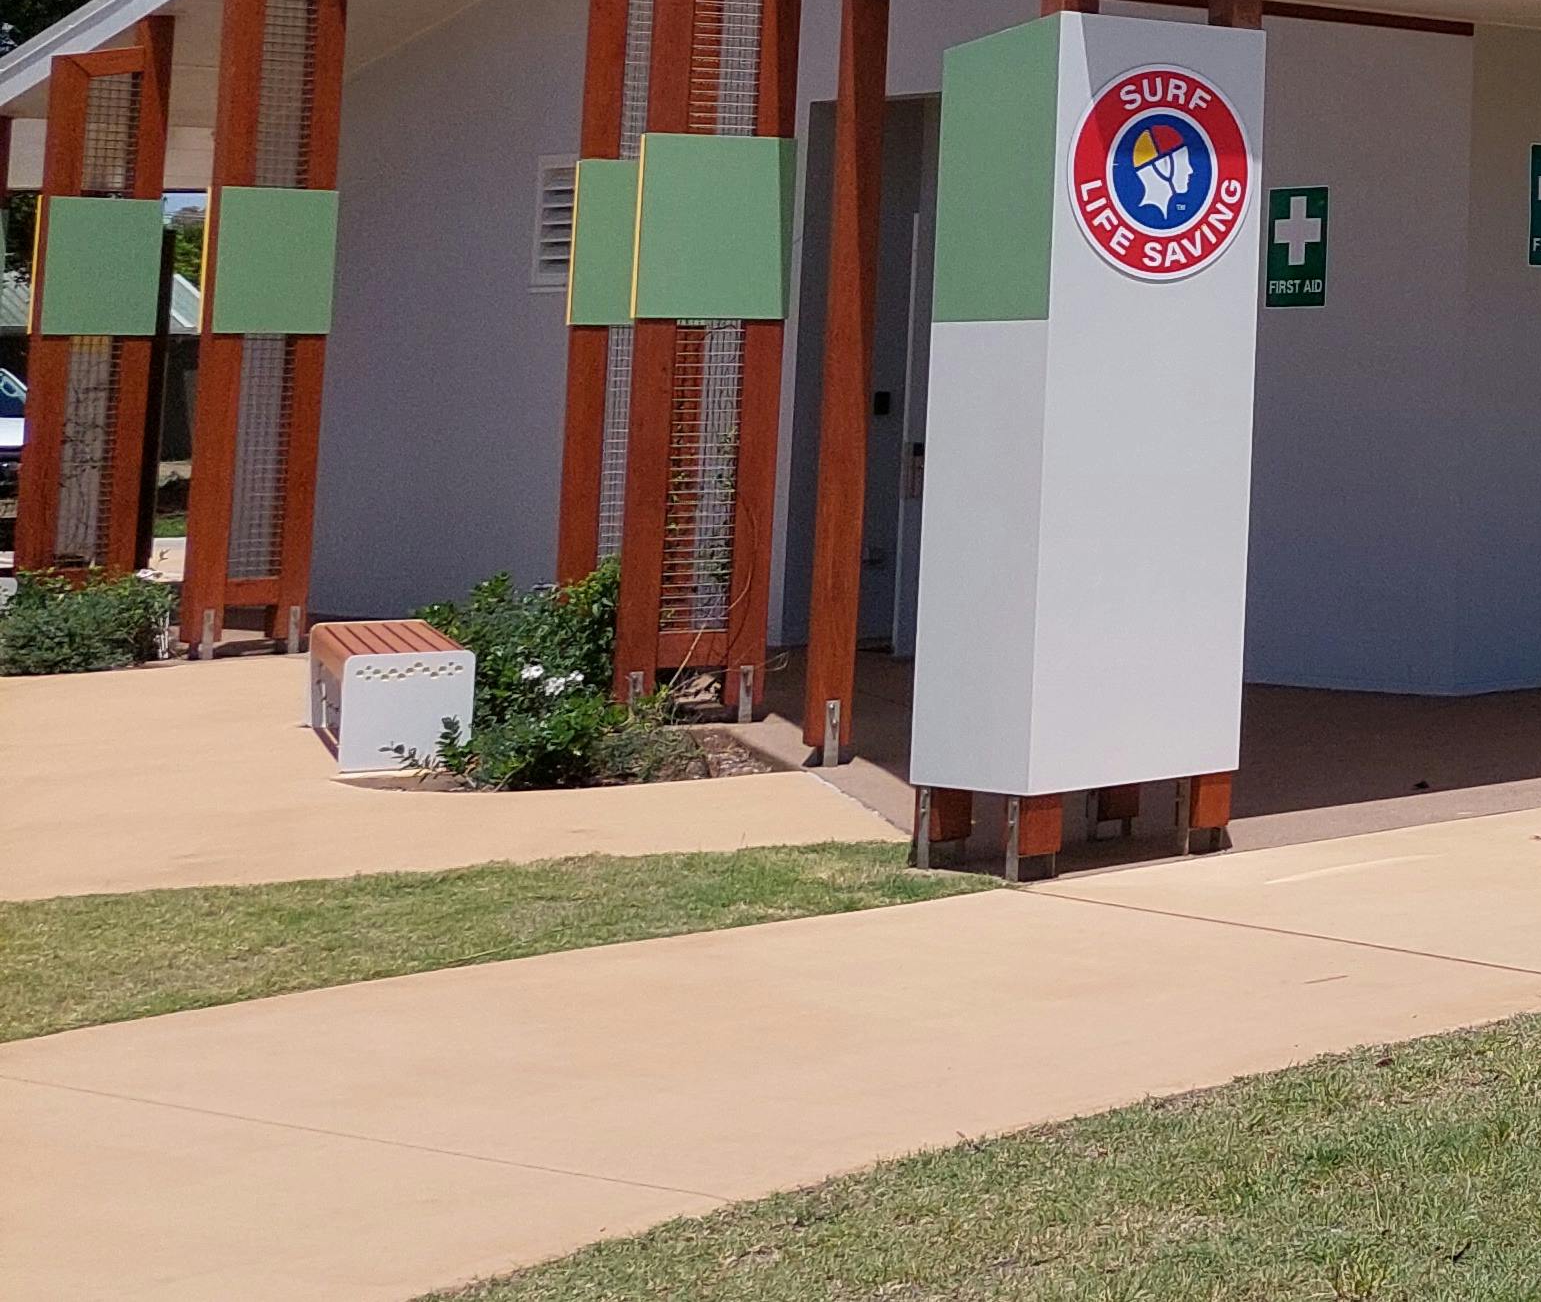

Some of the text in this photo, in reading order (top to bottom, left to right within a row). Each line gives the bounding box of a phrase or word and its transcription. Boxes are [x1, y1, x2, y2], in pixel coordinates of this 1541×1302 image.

[1119, 77, 1212, 111] SURF
[1080, 178, 1242, 268] LIFE SAVING
[1269, 279, 1323, 294] FIRST AID
